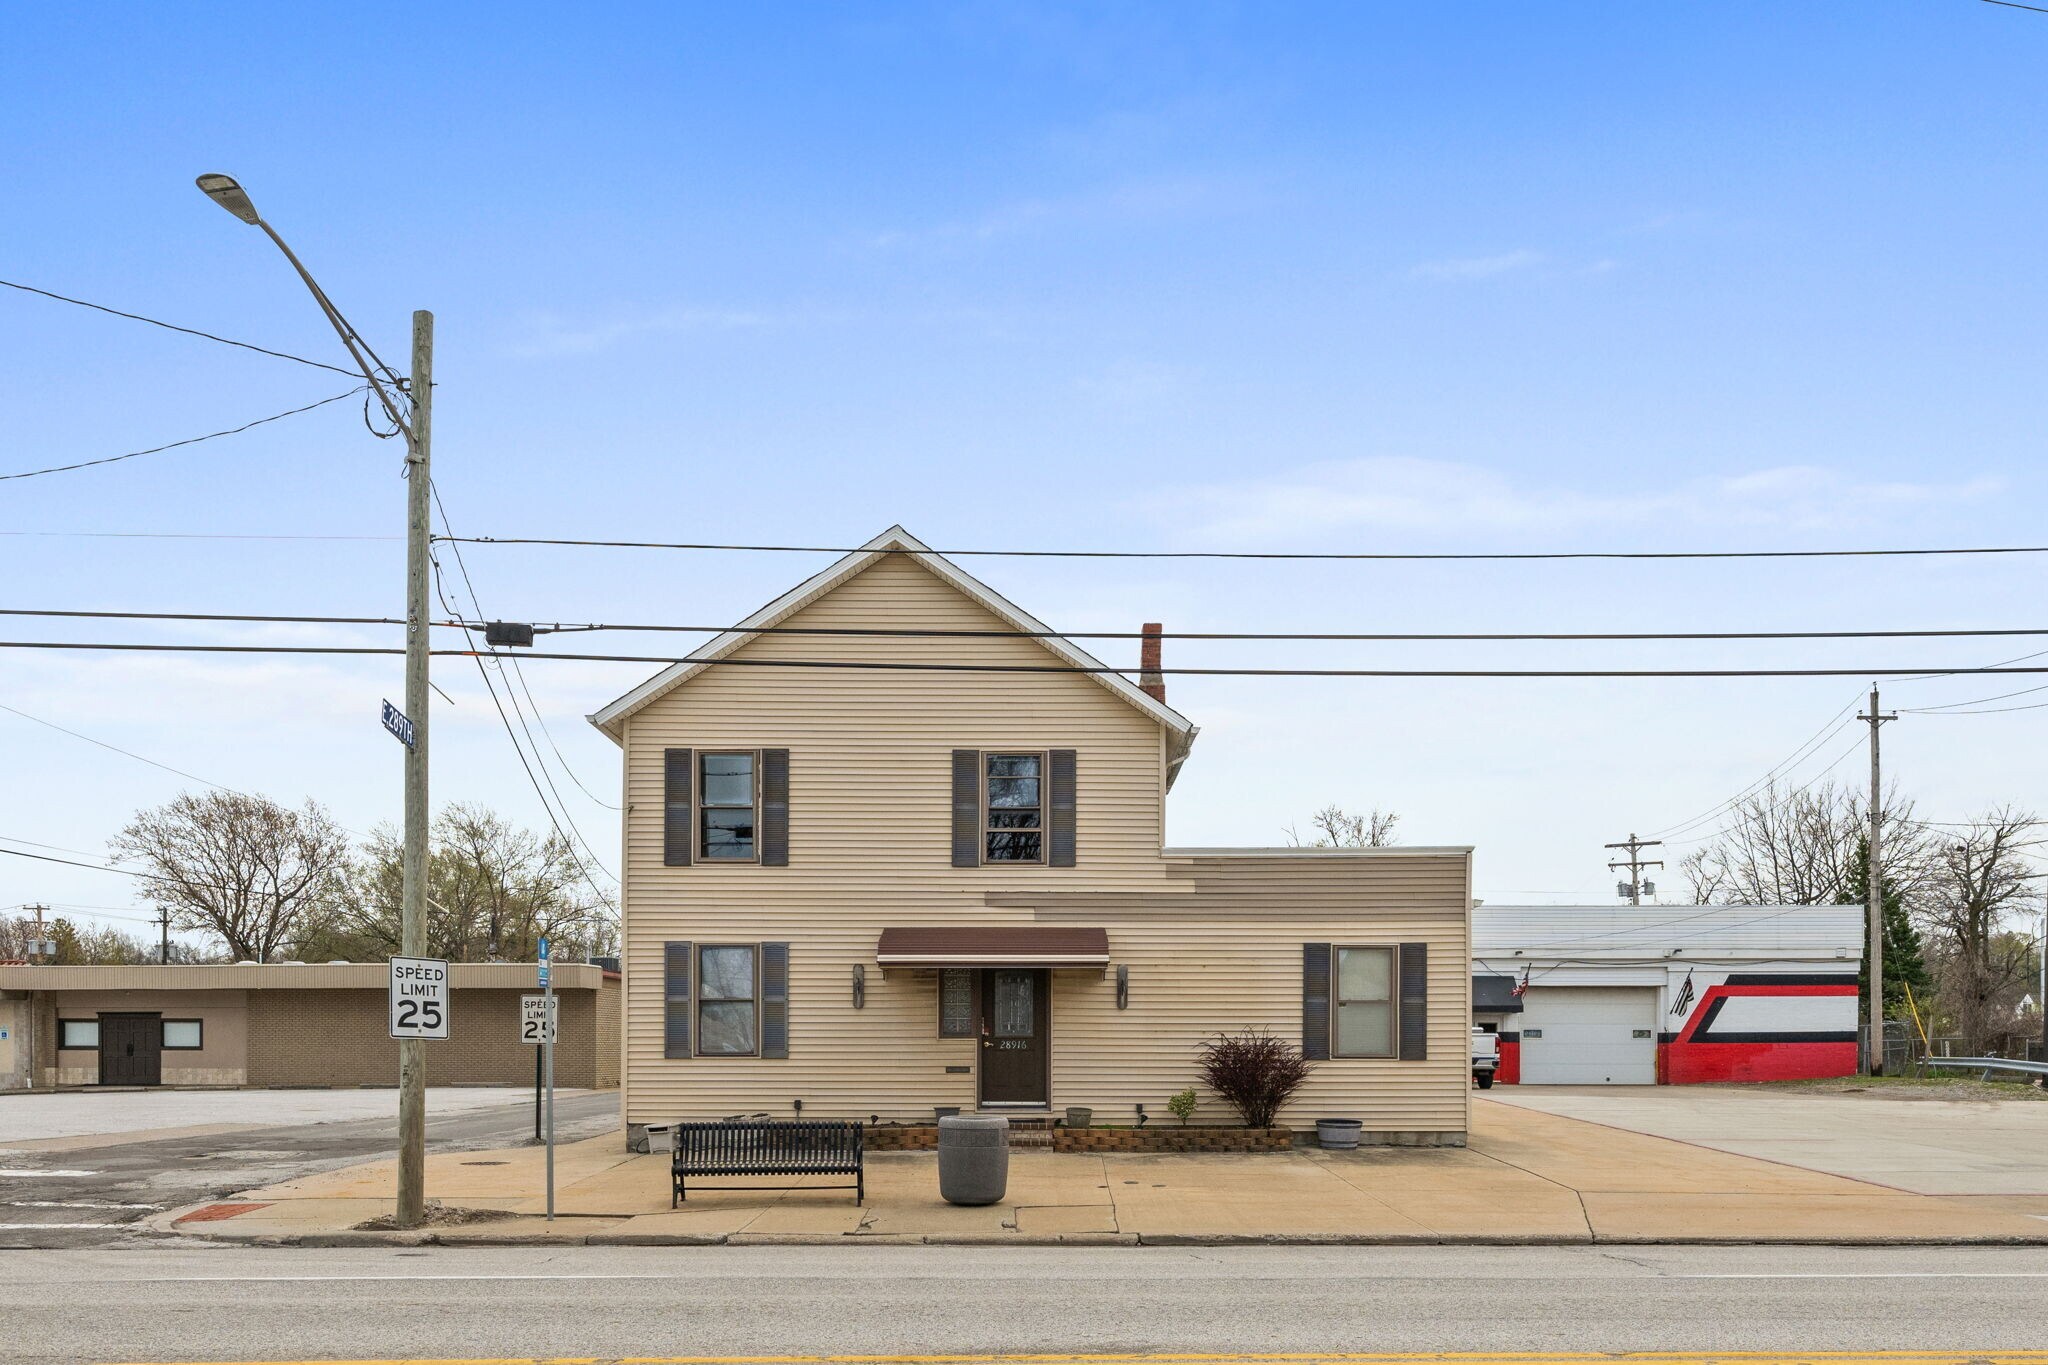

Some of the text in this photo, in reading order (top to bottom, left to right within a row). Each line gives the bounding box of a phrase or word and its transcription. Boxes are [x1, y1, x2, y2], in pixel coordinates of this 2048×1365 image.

[388, 707, 413, 744] 289TH
[395, 966, 444, 981] SPEED
[401, 983, 438, 997] LIMIT
[397, 999, 442, 1029] 25
[527, 1011, 546, 1019] LIMI
[999, 1040, 1027, 1050] 28916
